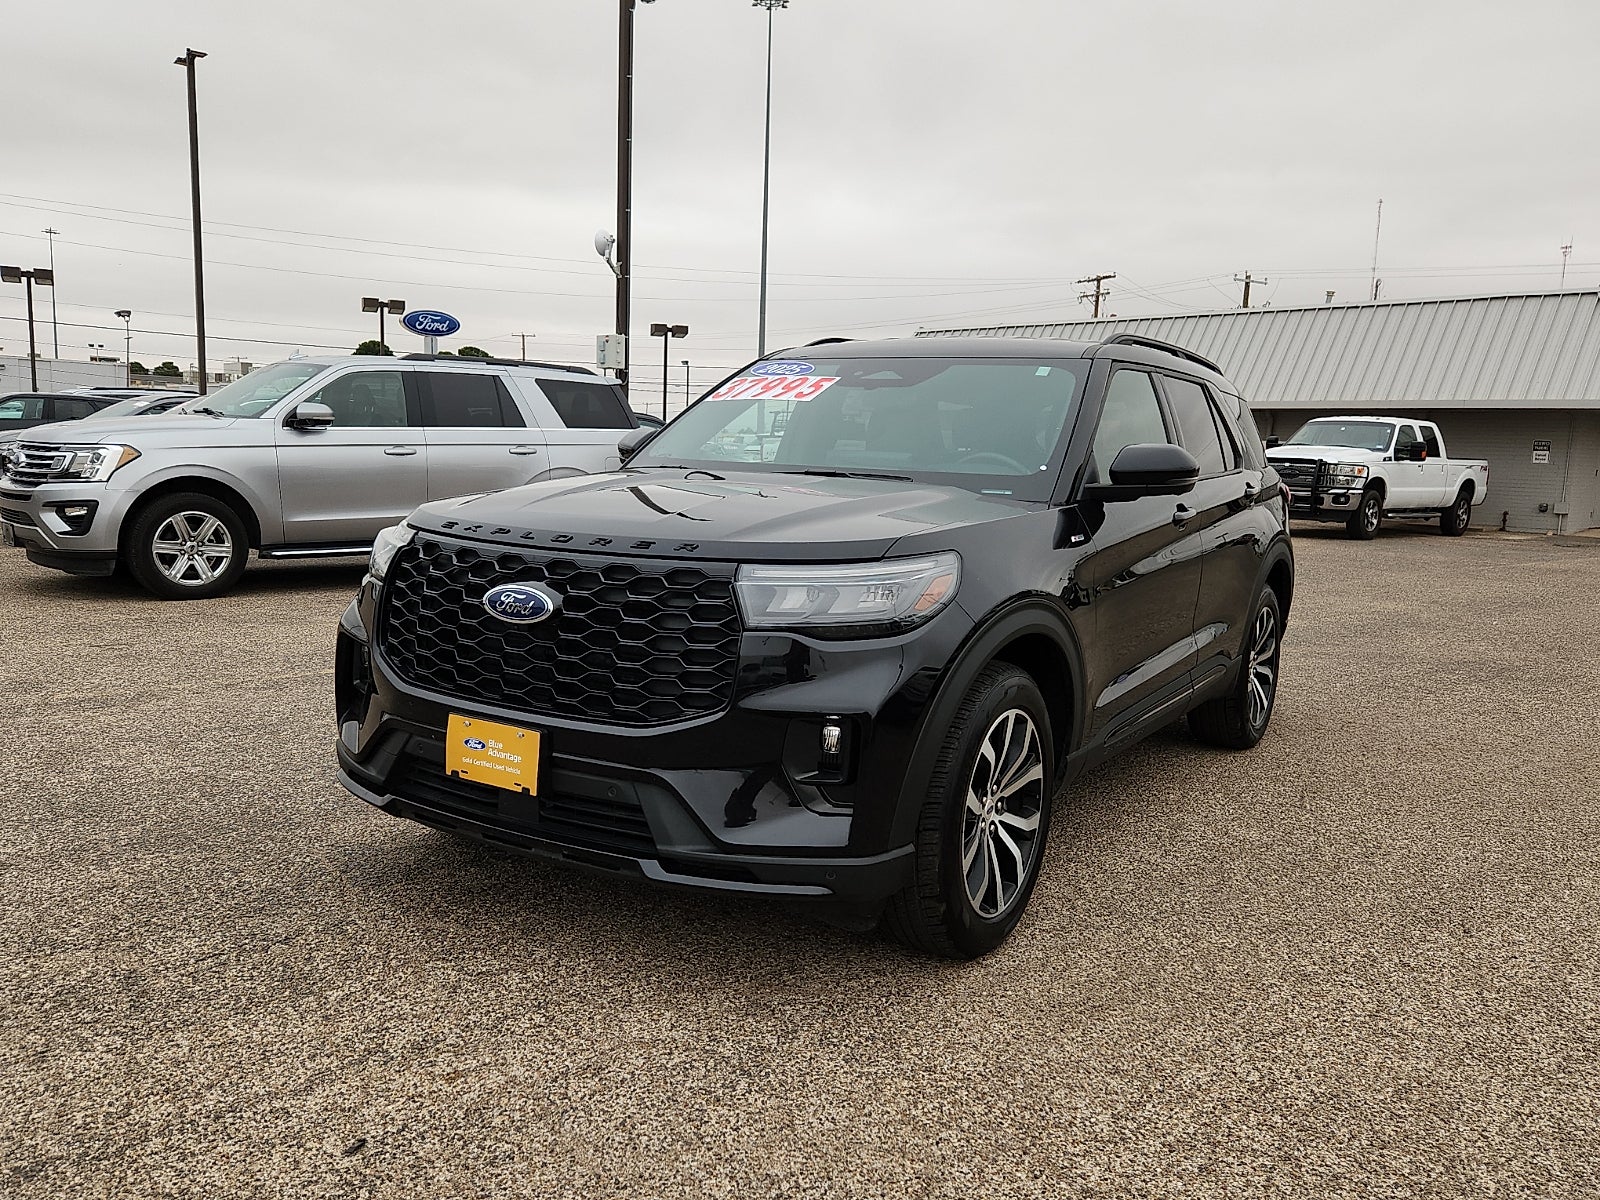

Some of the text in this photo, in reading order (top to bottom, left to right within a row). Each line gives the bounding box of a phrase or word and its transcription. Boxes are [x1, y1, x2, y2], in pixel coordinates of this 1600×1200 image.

[416, 314, 450, 332] Ford
[757, 364, 810, 374] 2025
[712, 376, 837, 399] 37995
[441, 520, 700, 553] EXPLORER
[496, 591, 536, 615] Ford
[467, 739, 483, 749] Ford
[488, 740, 503, 749] Blue
[488, 749, 522, 762] Advantage
[473, 758, 492, 768] Certified
[493, 762, 505, 770] Used
[505, 765, 520, 774] Vehicle
